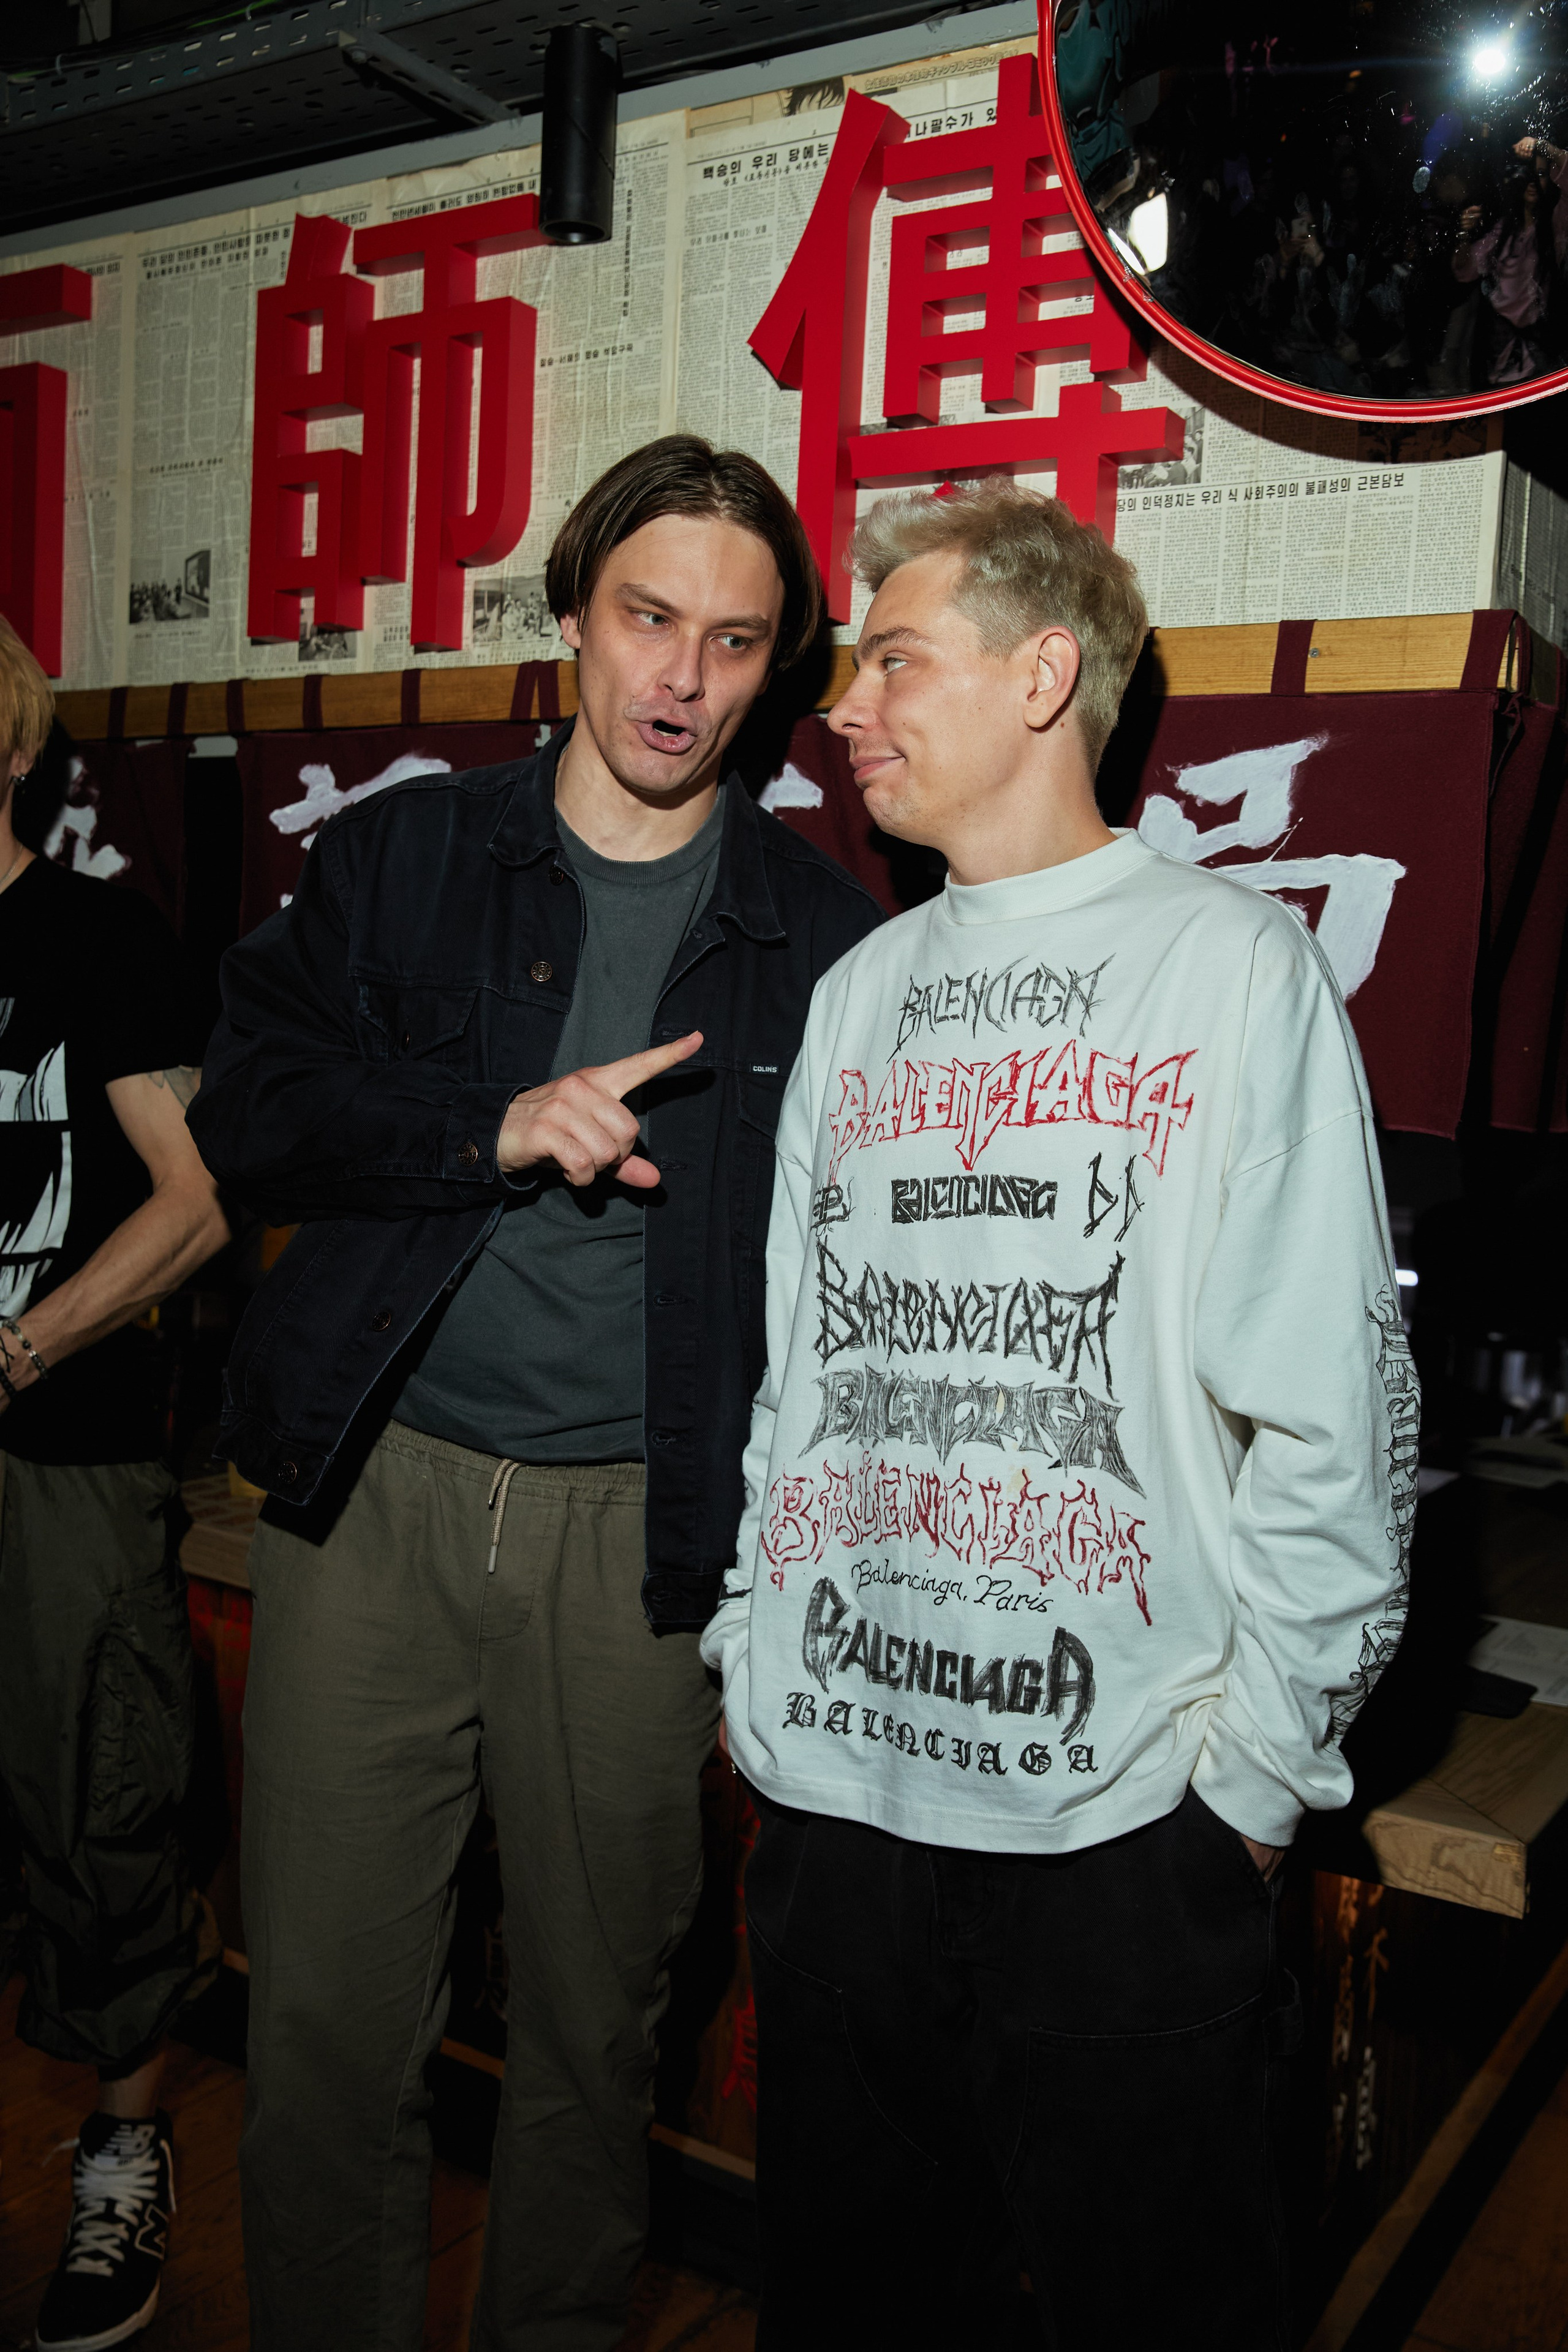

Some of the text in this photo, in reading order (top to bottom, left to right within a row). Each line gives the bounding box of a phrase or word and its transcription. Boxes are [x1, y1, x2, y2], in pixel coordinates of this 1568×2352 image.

[703, 160, 741, 179] 백승의
[752, 153, 777, 170] 우리
[789, 143, 829, 163] 당에는
[1117, 472, 1404, 512] 당의 인덕정치는 우리 식 사회주의의 불패성의 근본담보
[974, 1575, 1054, 1613] Paris
